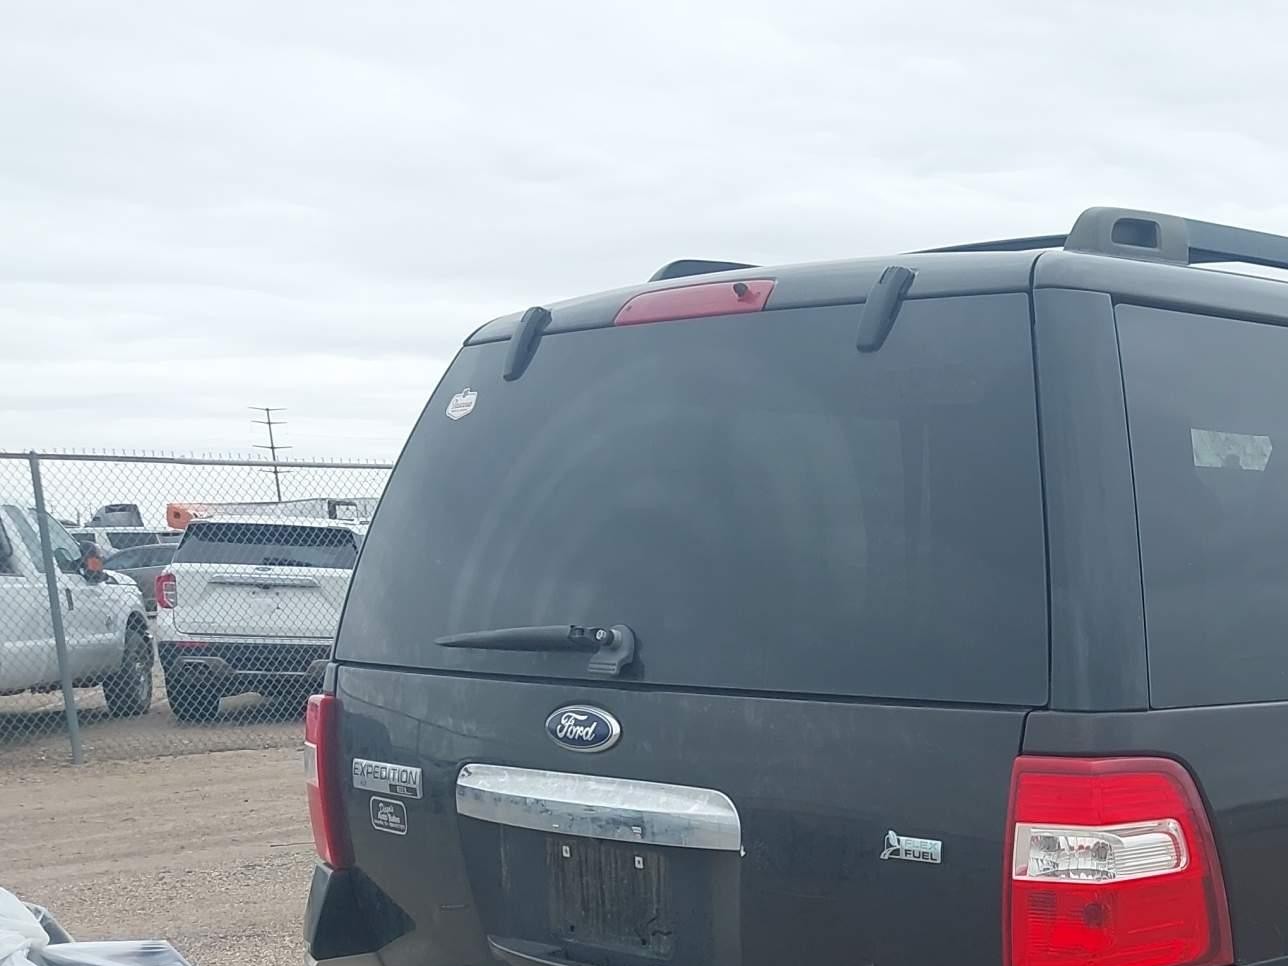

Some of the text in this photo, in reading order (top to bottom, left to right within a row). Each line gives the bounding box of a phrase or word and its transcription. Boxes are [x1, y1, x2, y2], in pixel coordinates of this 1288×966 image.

[556, 712, 598, 741] Ford
[353, 761, 418, 785] EXPEDITION
[904, 839, 938, 851] FLEX
[904, 849, 938, 861] FUEL
